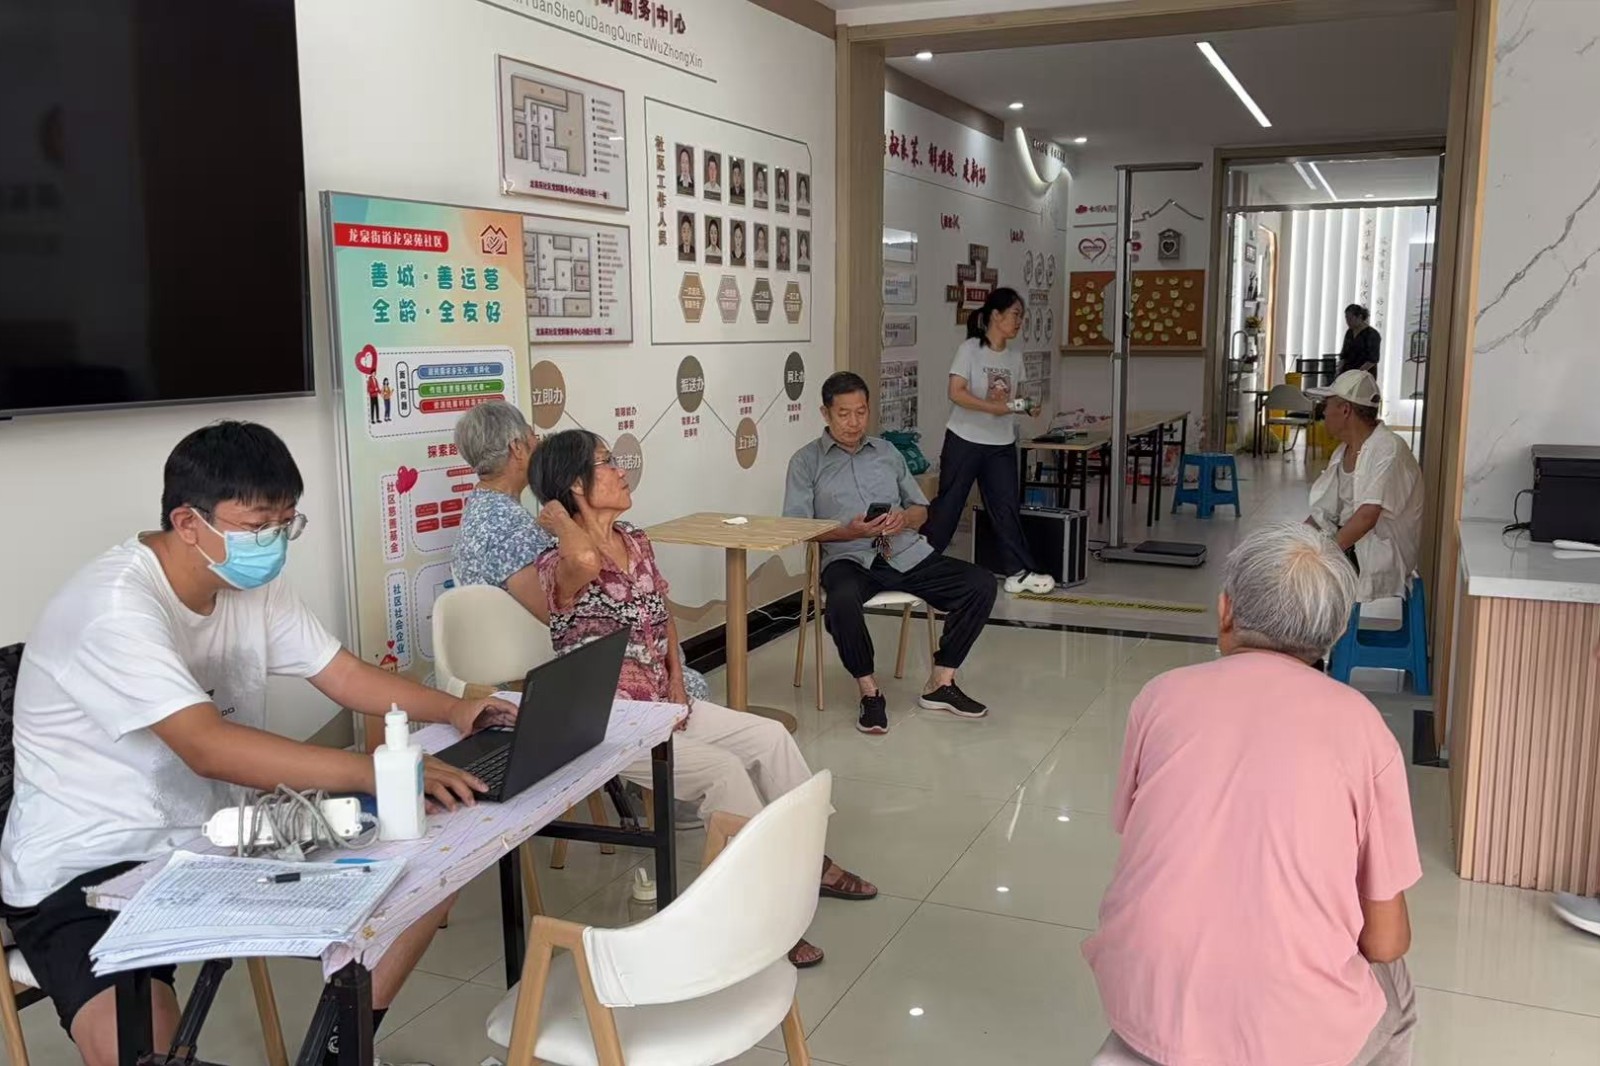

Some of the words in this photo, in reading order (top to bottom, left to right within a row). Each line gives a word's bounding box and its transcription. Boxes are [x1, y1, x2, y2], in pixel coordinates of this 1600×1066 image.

[600, 0, 686, 34] 服务中心
[513, 0, 703, 68] uanSheQuDangQunFuWuZhongXin
[655, 135, 667, 246] 社区工作人员
[348, 228, 443, 248] 龙泉街道龙泉苑社区
[370, 262, 500, 291] 善城·善运营
[372, 298, 501, 324] 全龄·全友好
[532, 387, 563, 406] 立即办
